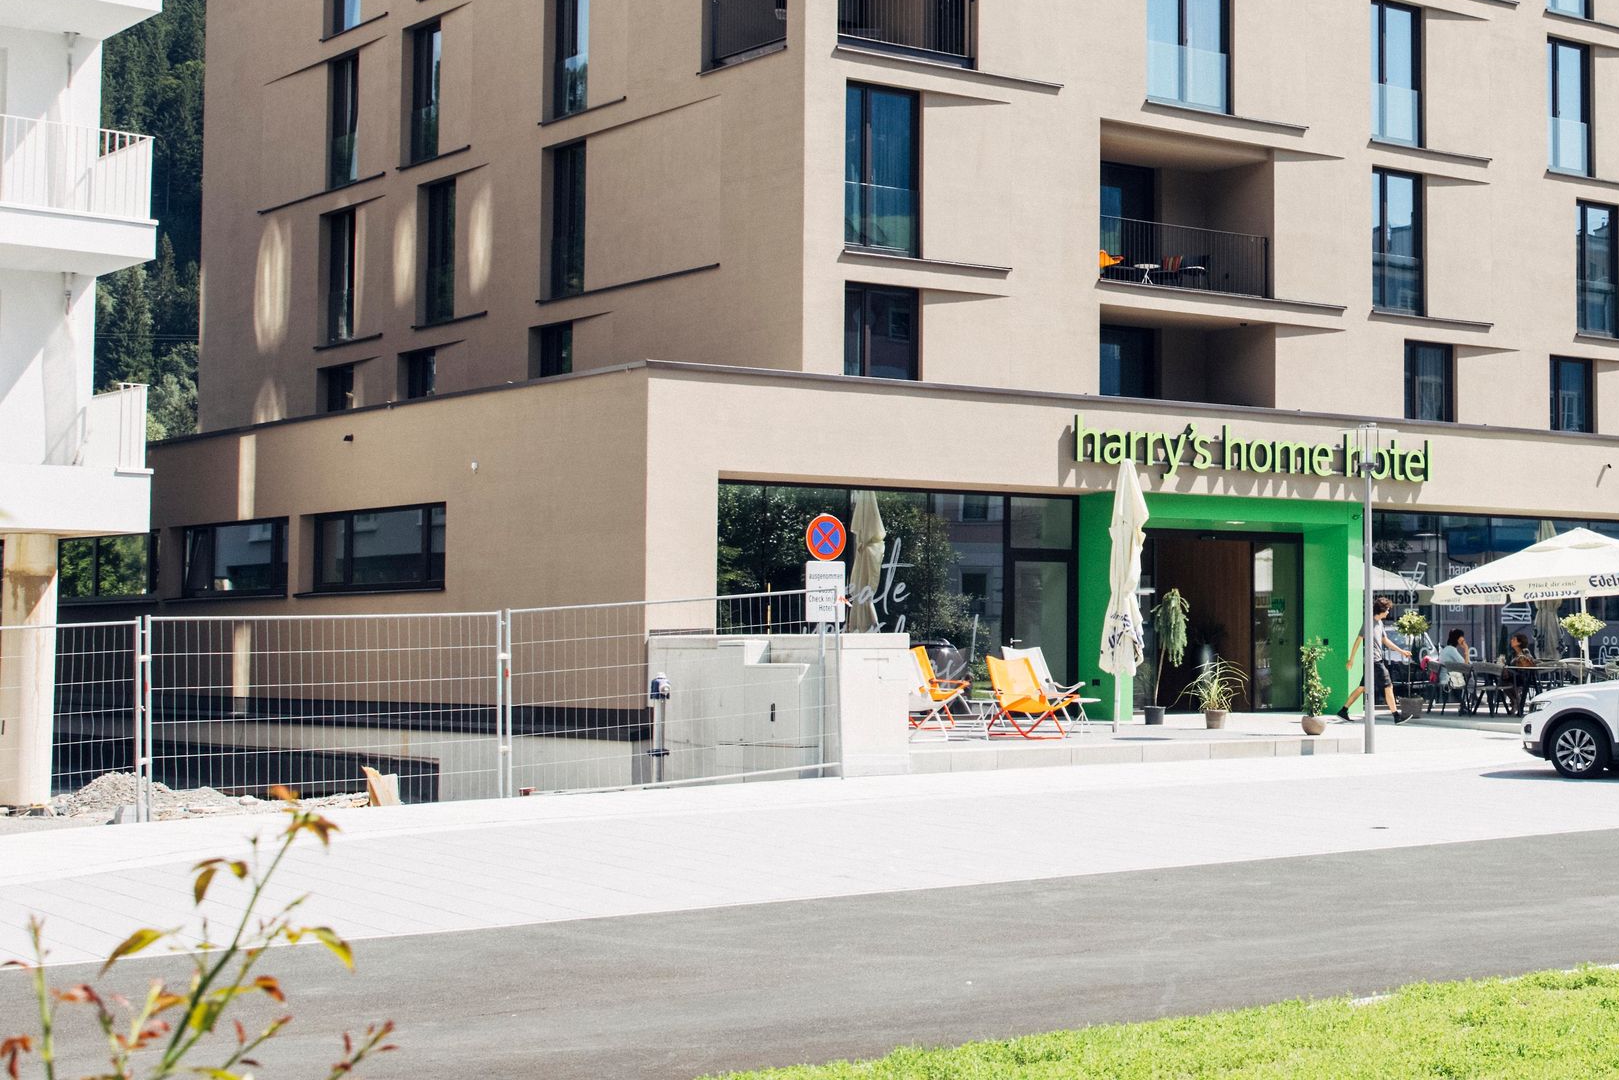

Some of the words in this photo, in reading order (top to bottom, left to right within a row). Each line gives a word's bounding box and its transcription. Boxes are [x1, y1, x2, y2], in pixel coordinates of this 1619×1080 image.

[1074, 414, 1212, 480] harry's
[1222, 423, 1334, 477] home
[1343, 433, 1433, 482] hotel
[1453, 582, 1516, 596] Edelweiss
